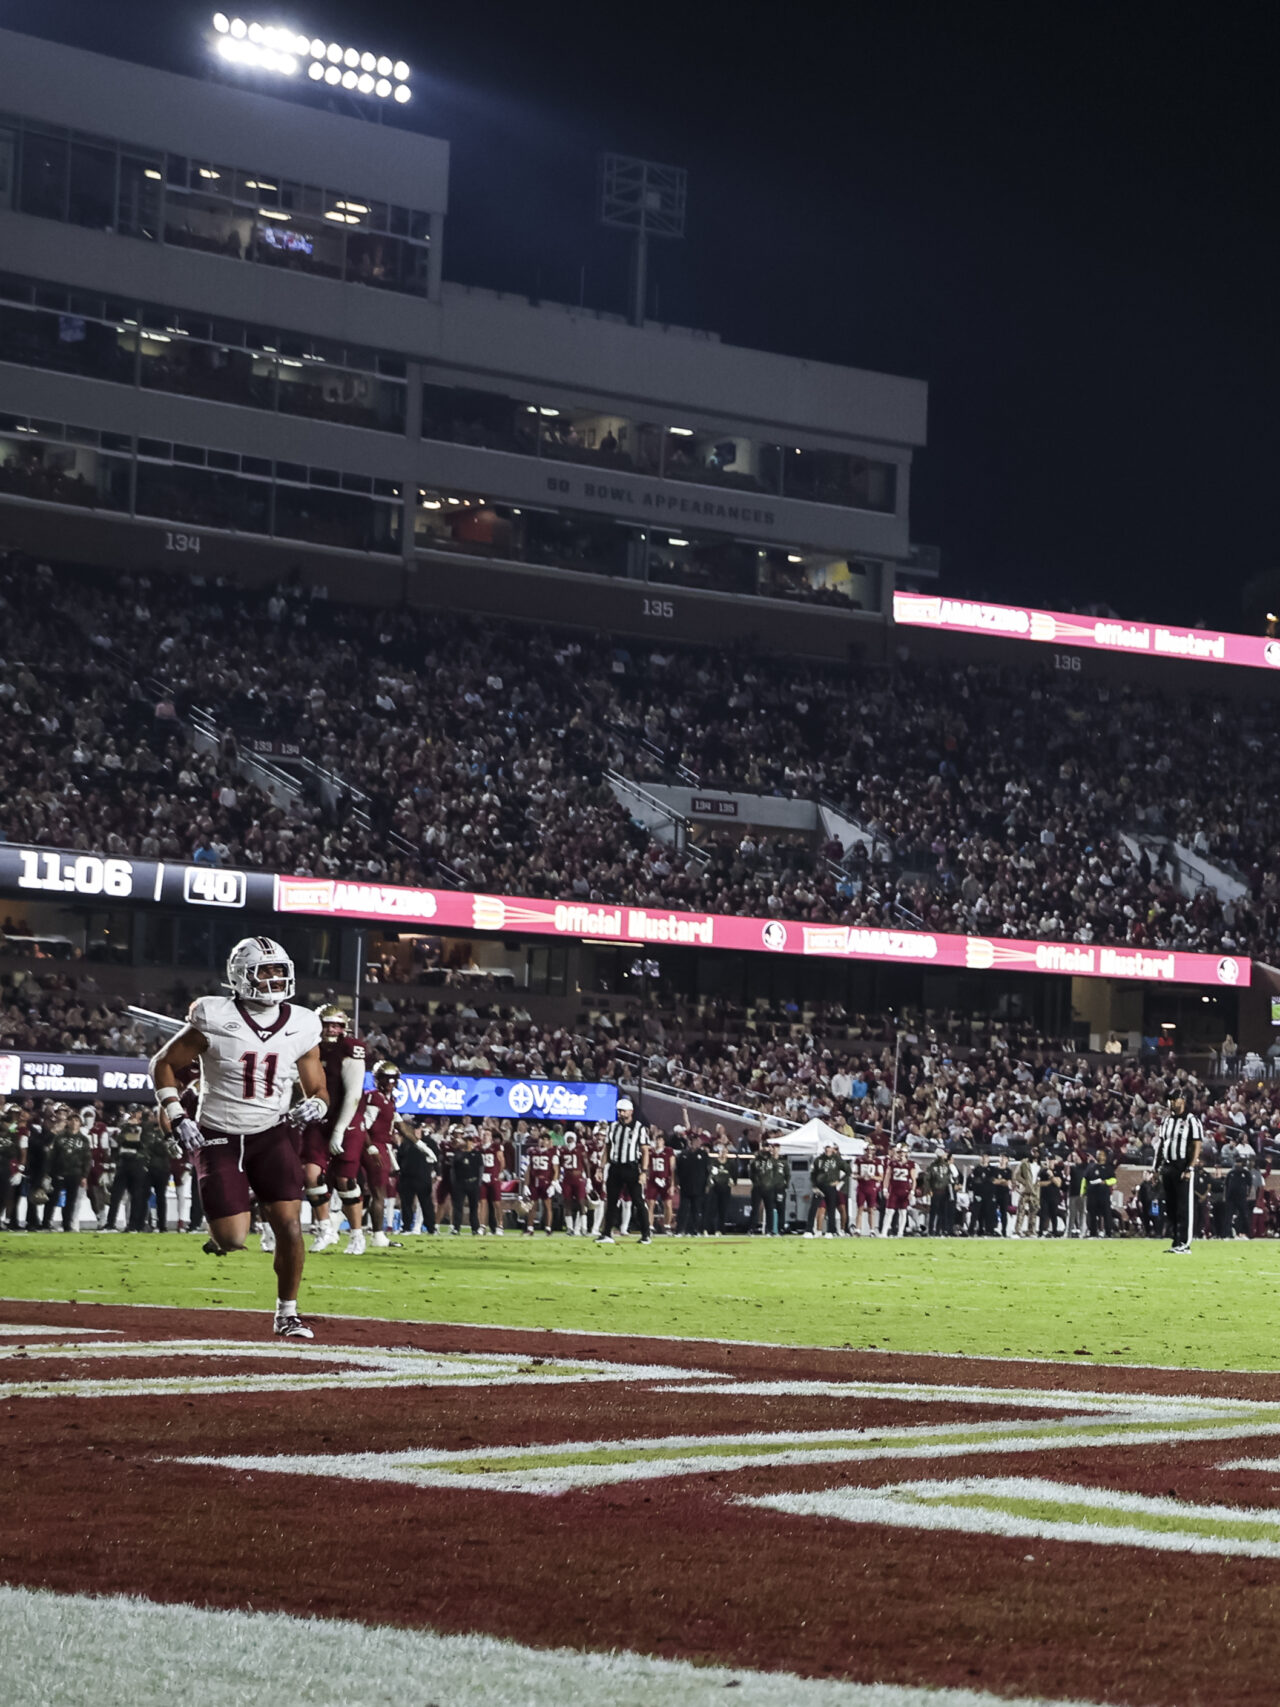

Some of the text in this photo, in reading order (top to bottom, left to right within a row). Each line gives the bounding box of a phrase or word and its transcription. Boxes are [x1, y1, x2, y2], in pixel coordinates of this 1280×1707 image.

[584, 482, 634, 505] BOWL
[641, 493, 776, 525] APPEARANCES
[165, 531, 201, 554] 134
[643, 598, 674, 618] 135
[1094, 622, 1150, 650] Official
[1155, 629, 1225, 659] Mustard
[1053, 653, 1082, 672] 136
[281, 742, 300, 755] 134
[695, 799, 736, 814] 134 135
[18, 850, 133, 897] 11:06
[192, 871, 238, 903] 40
[554, 904, 622, 937] Official
[628, 908, 714, 945] Mustard
[1035, 944, 1095, 973] Official
[1099, 948, 1175, 979] Mustard
[256, 1030, 273, 1039] VT
[35, 1075, 98, 1093] STOCKTON
[239, 1051, 281, 1099] 11
[406, 1078, 467, 1109] VyStar
[532, 1084, 588, 1115] VyStar
[563, 1154, 578, 1169] 21
[893, 1167, 909, 1181] 22
